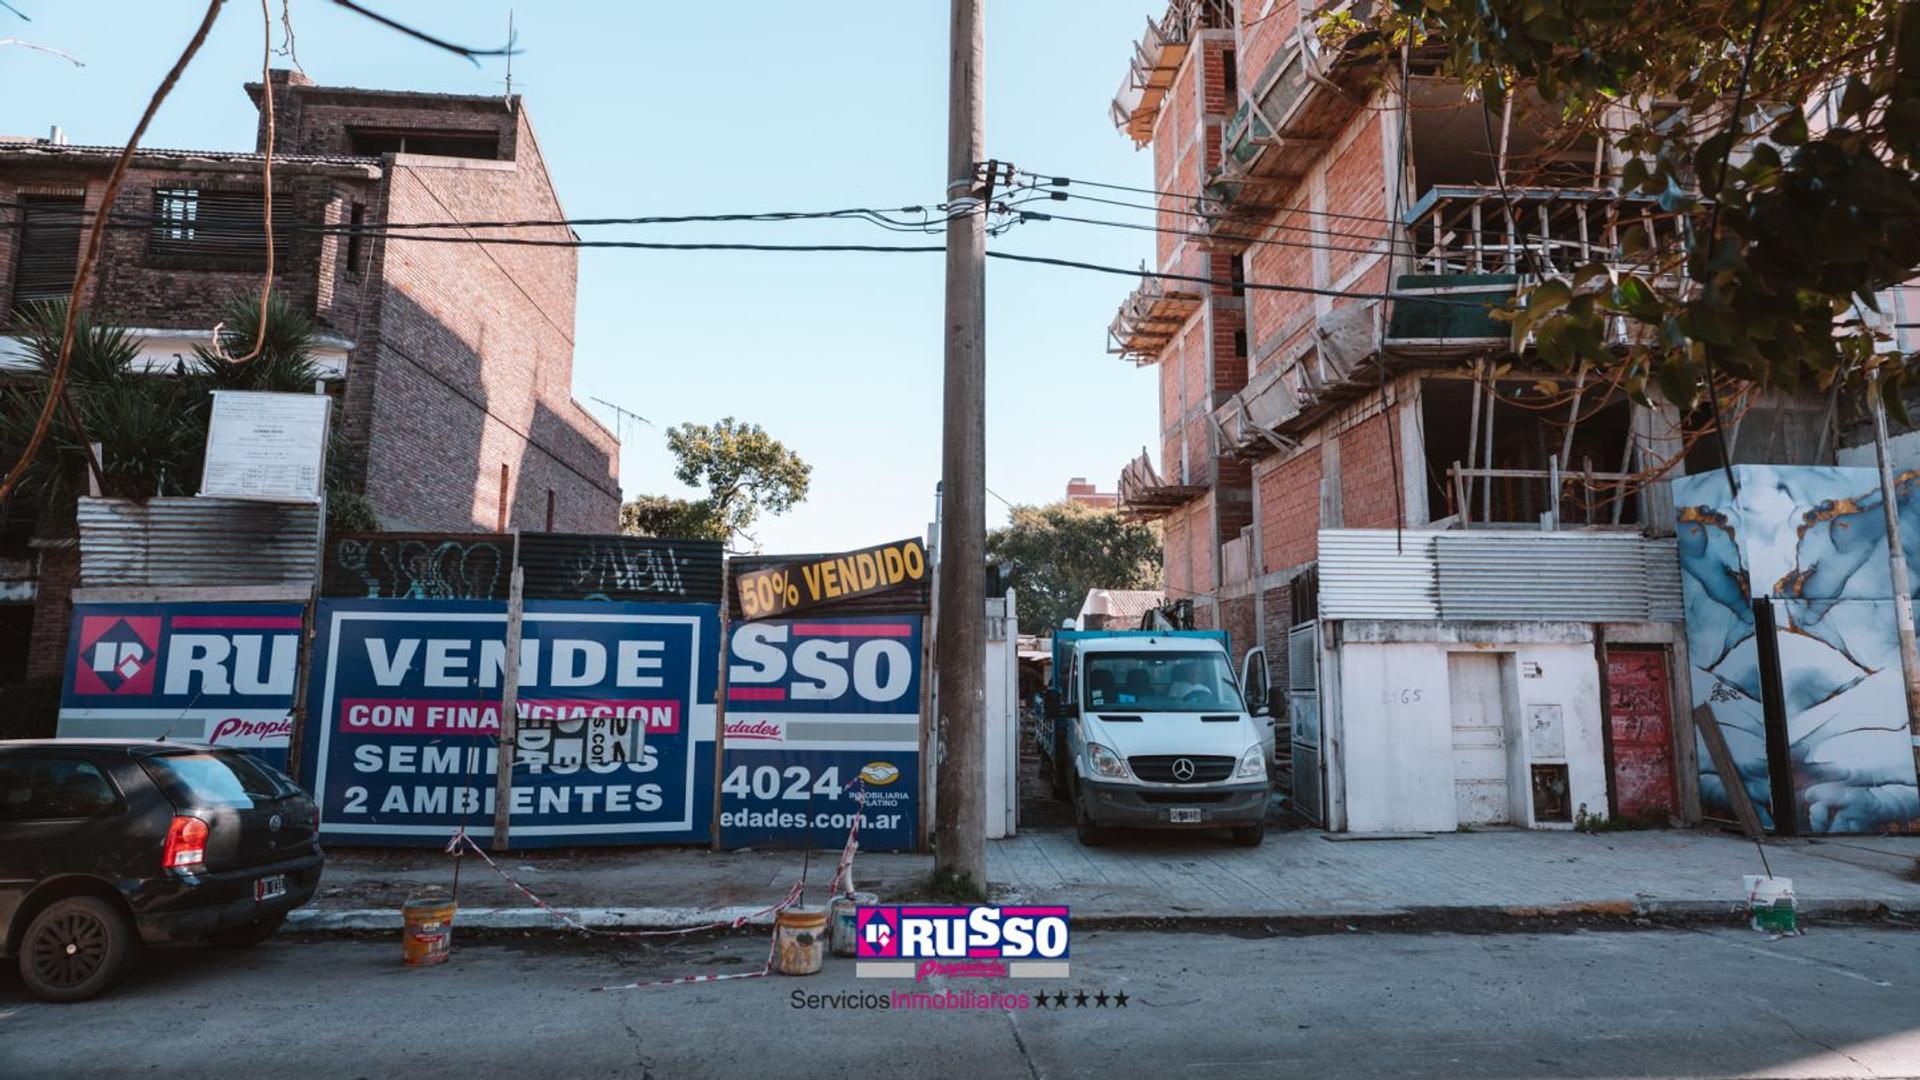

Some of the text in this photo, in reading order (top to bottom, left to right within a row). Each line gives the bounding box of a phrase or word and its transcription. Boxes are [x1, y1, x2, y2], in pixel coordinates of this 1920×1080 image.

[741, 569, 799, 615] 50%
[802, 542, 924, 601] VENDIDO
[163, 634, 299, 695] RU
[364, 638, 665, 688] VENDE
[729, 622, 912, 702] SSO
[349, 705, 415, 727] CON
[343, 783, 663, 814] 2 AMBIENTES
[721, 765, 842, 800] 4024
[720, 808, 901, 830] edades.com.ar
